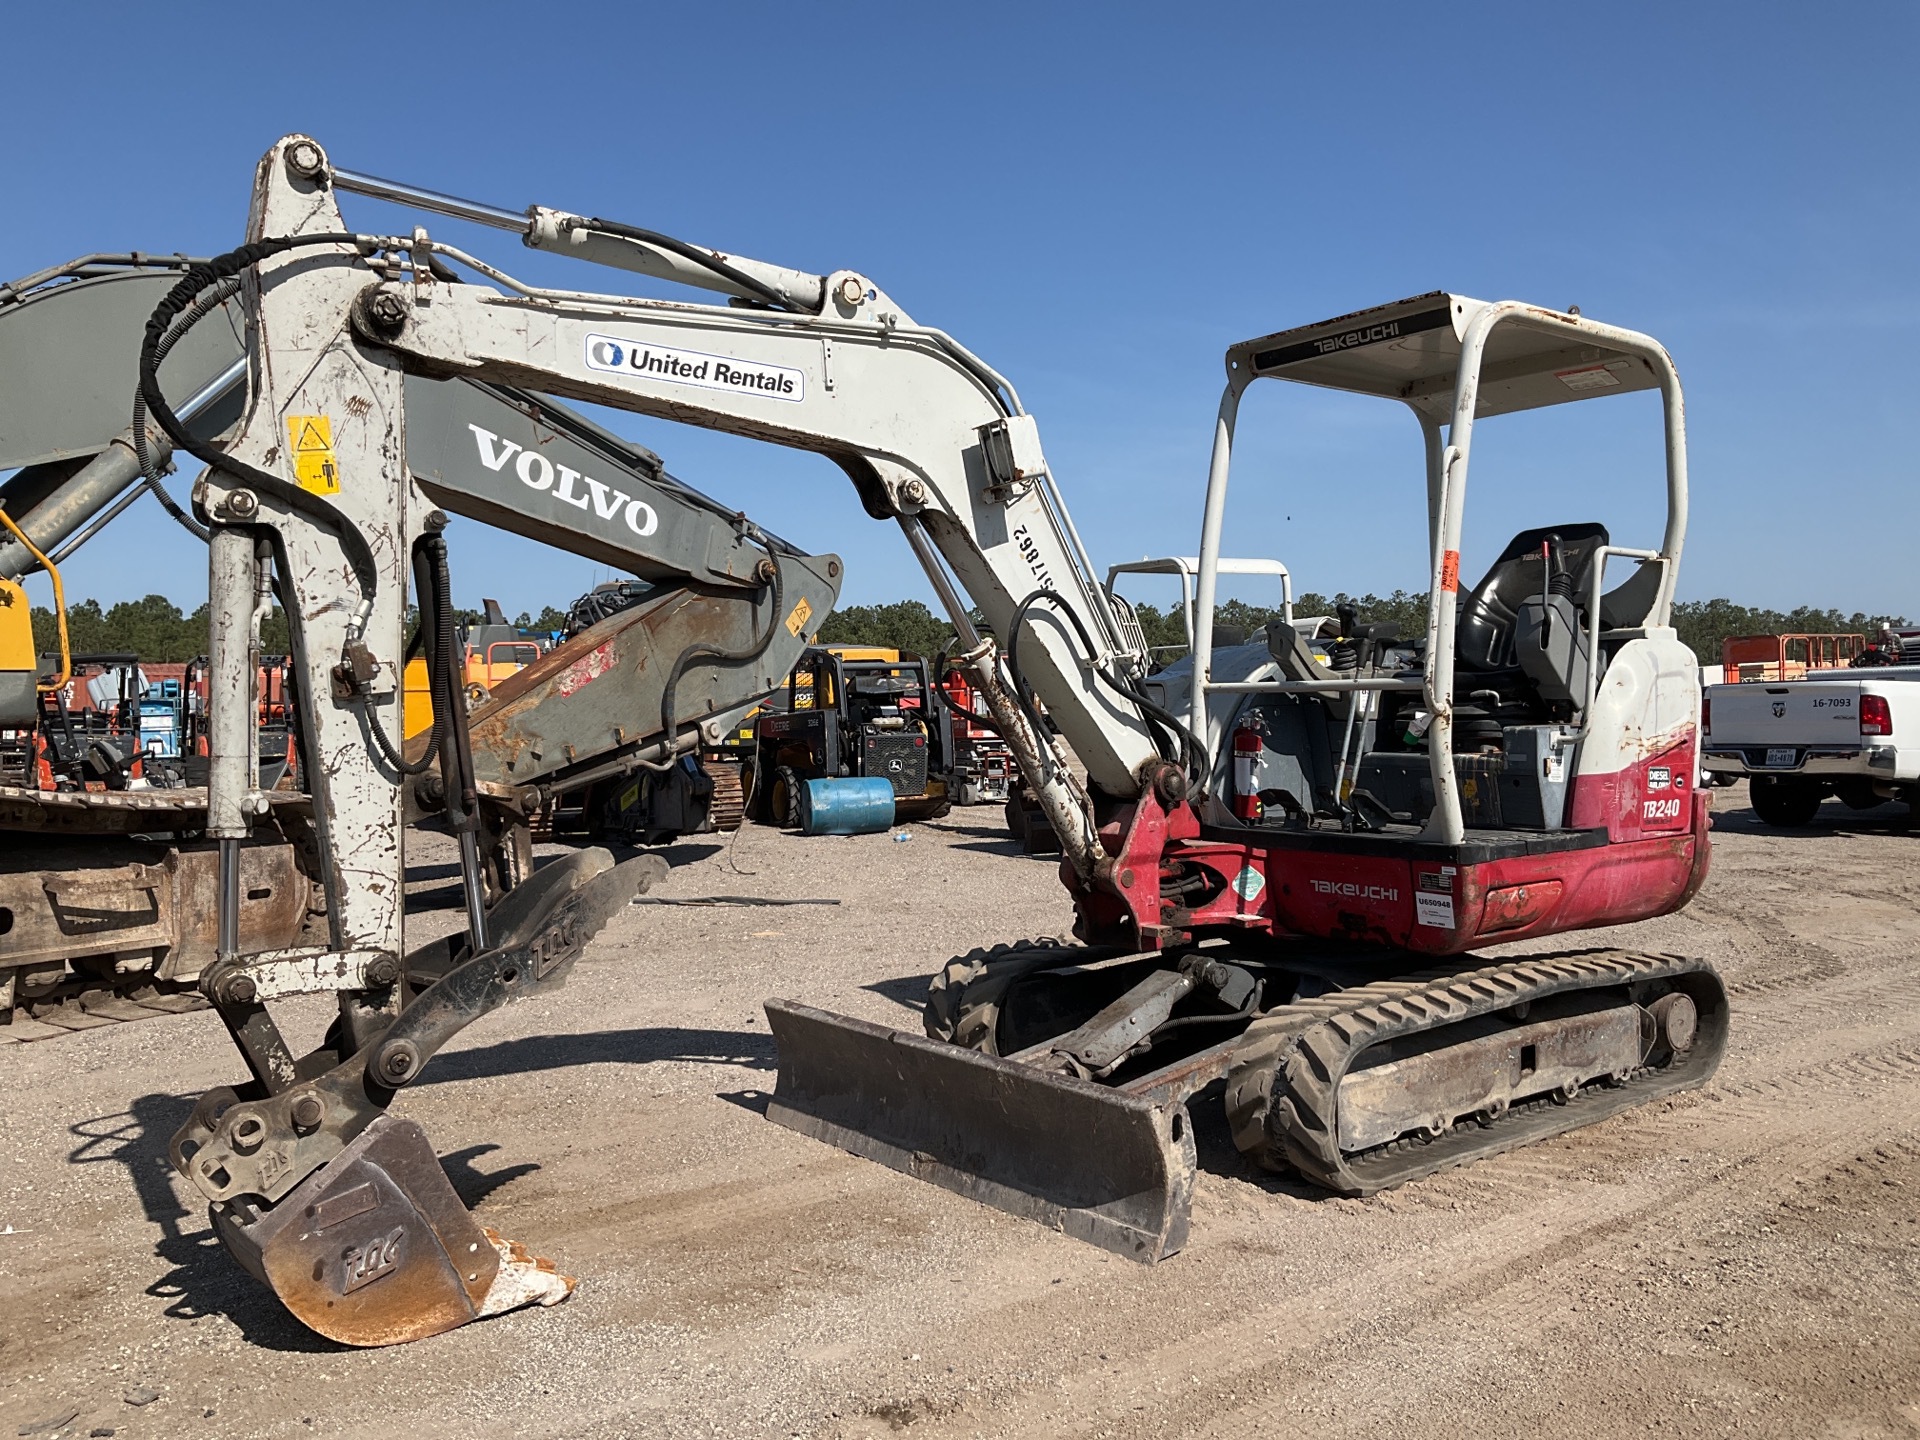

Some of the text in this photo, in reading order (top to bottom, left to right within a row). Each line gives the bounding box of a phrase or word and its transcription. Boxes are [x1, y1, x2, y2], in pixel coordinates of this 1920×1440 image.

[1313, 322, 1399, 353] TAKEUCHI
[629, 348, 794, 394] United Rentals
[468, 423, 659, 537] VOLVO
[1812, 698, 1851, 708] 16-7093
[1649, 770, 1669, 780] DIESEL
[1643, 798, 1680, 818] TB240
[1310, 879, 1399, 901] TAKEUCHI
[1418, 898, 1451, 908] U650948
